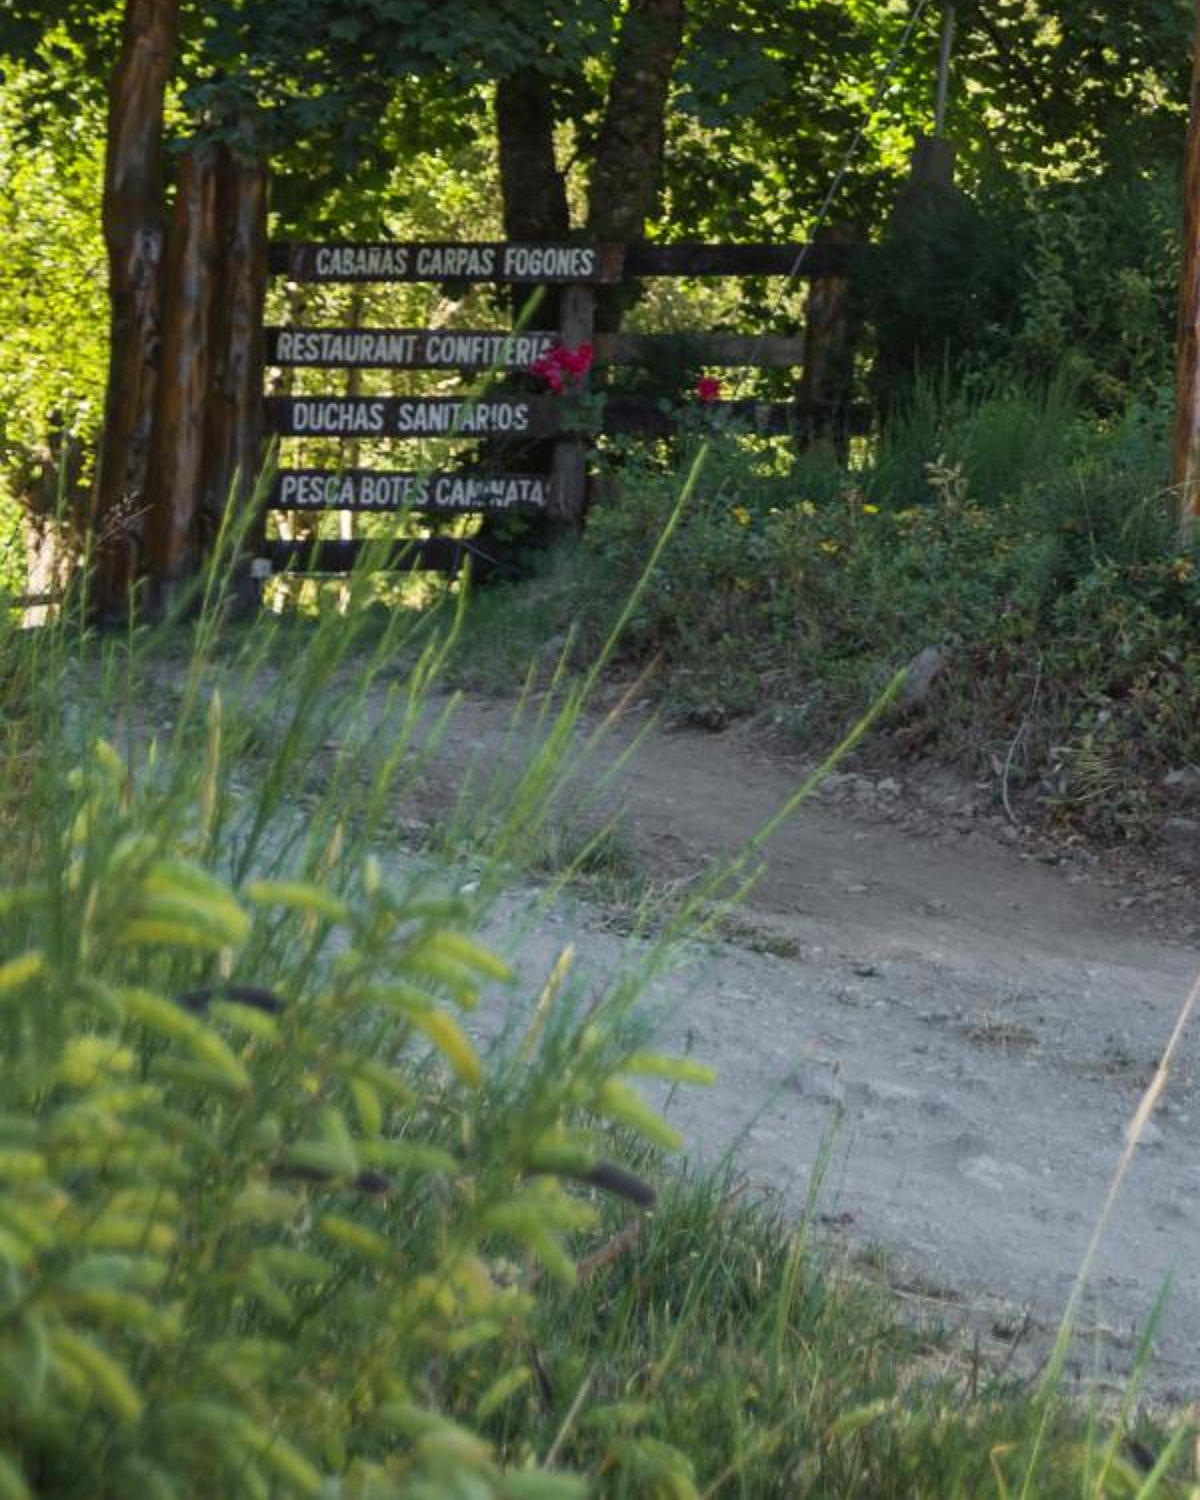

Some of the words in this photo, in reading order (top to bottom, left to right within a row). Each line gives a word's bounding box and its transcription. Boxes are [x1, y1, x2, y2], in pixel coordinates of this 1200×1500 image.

[316, 247, 408, 275] CABAÑAS
[416, 248, 495, 275] CARPAS
[503, 248, 595, 276] FOGONES
[277, 332, 417, 362] RESTAURANT
[293, 402, 384, 430] DUCHAS
[397, 403, 528, 430] SANITARIOS
[281, 475, 353, 504] PESCA
[359, 476, 429, 505] BOTES
